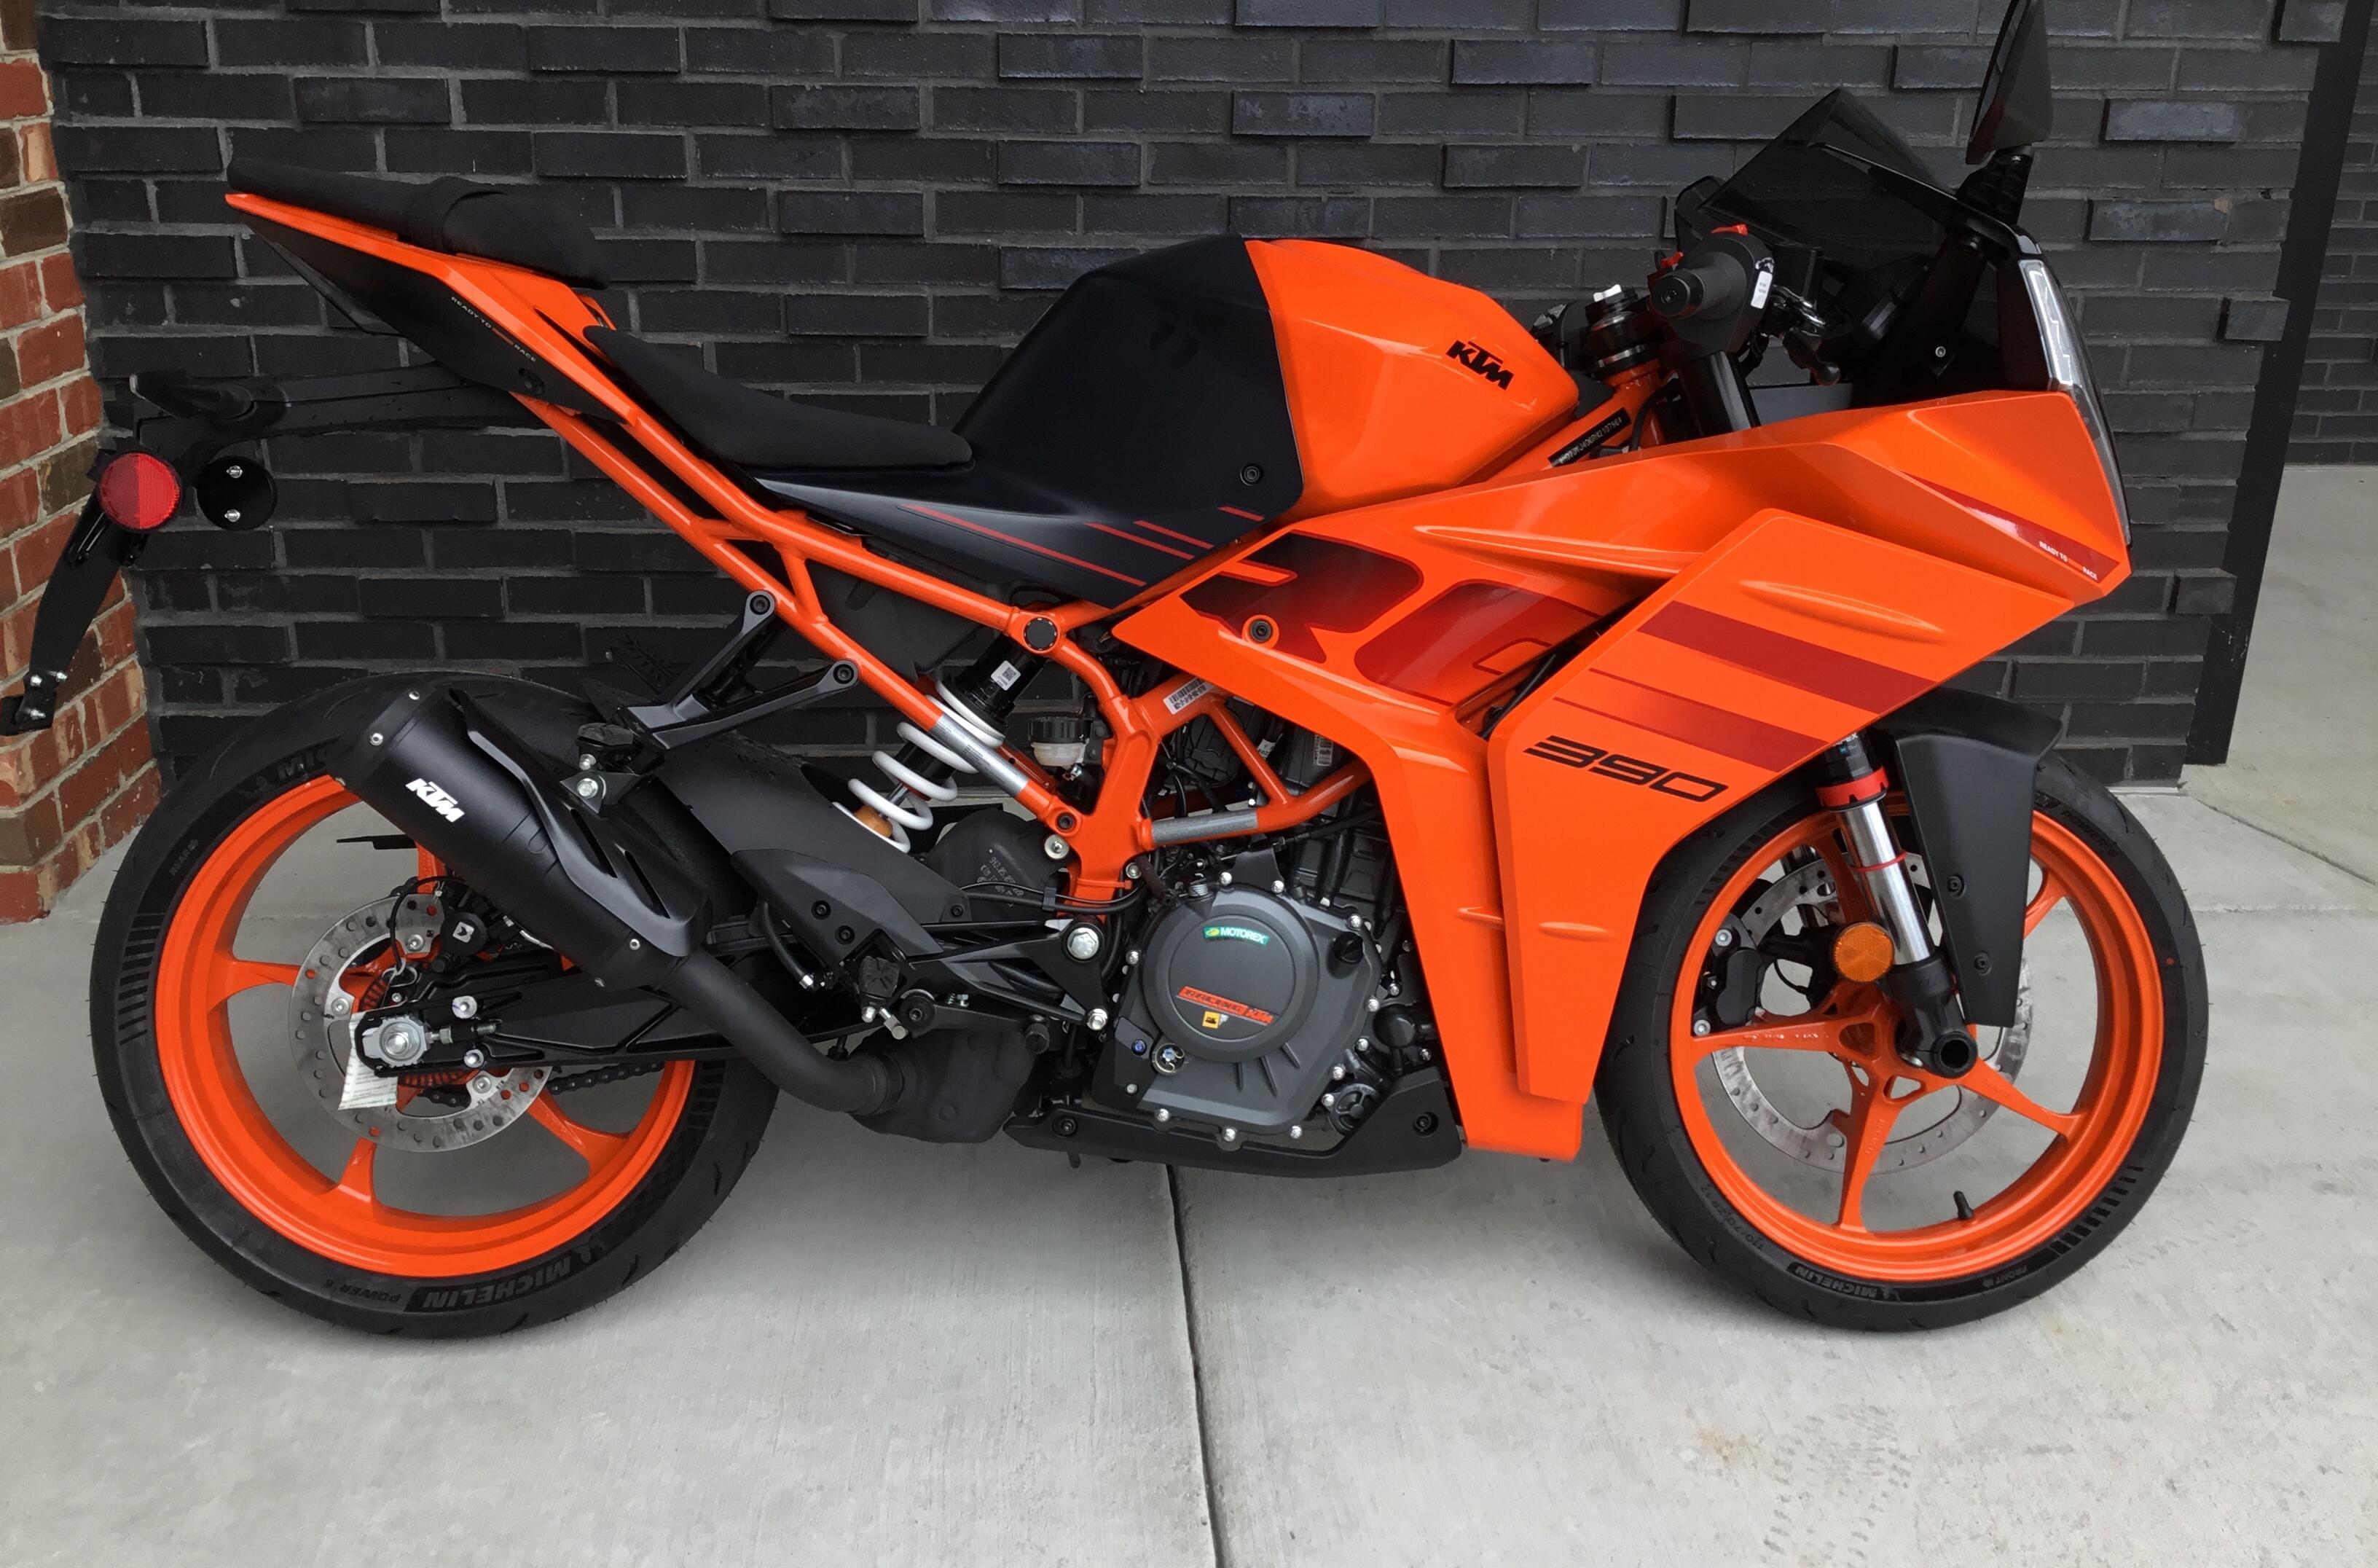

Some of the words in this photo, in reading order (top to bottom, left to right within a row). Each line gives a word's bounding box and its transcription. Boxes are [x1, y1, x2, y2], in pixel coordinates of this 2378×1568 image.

[451, 296, 479, 318] READY
[480, 318, 492, 329] TO
[514, 344, 537, 362] RACE
[1445, 340, 1514, 391] KTM
[1523, 734, 1729, 802] 390
[405, 778, 465, 823] KTM
[1220, 927, 1268, 944] MOTOREX
[422, 1255, 572, 1309] MICHELIN
[1794, 1266, 1877, 1300] MICHELIN
[1996, 1264, 2027, 1287] FRONT
